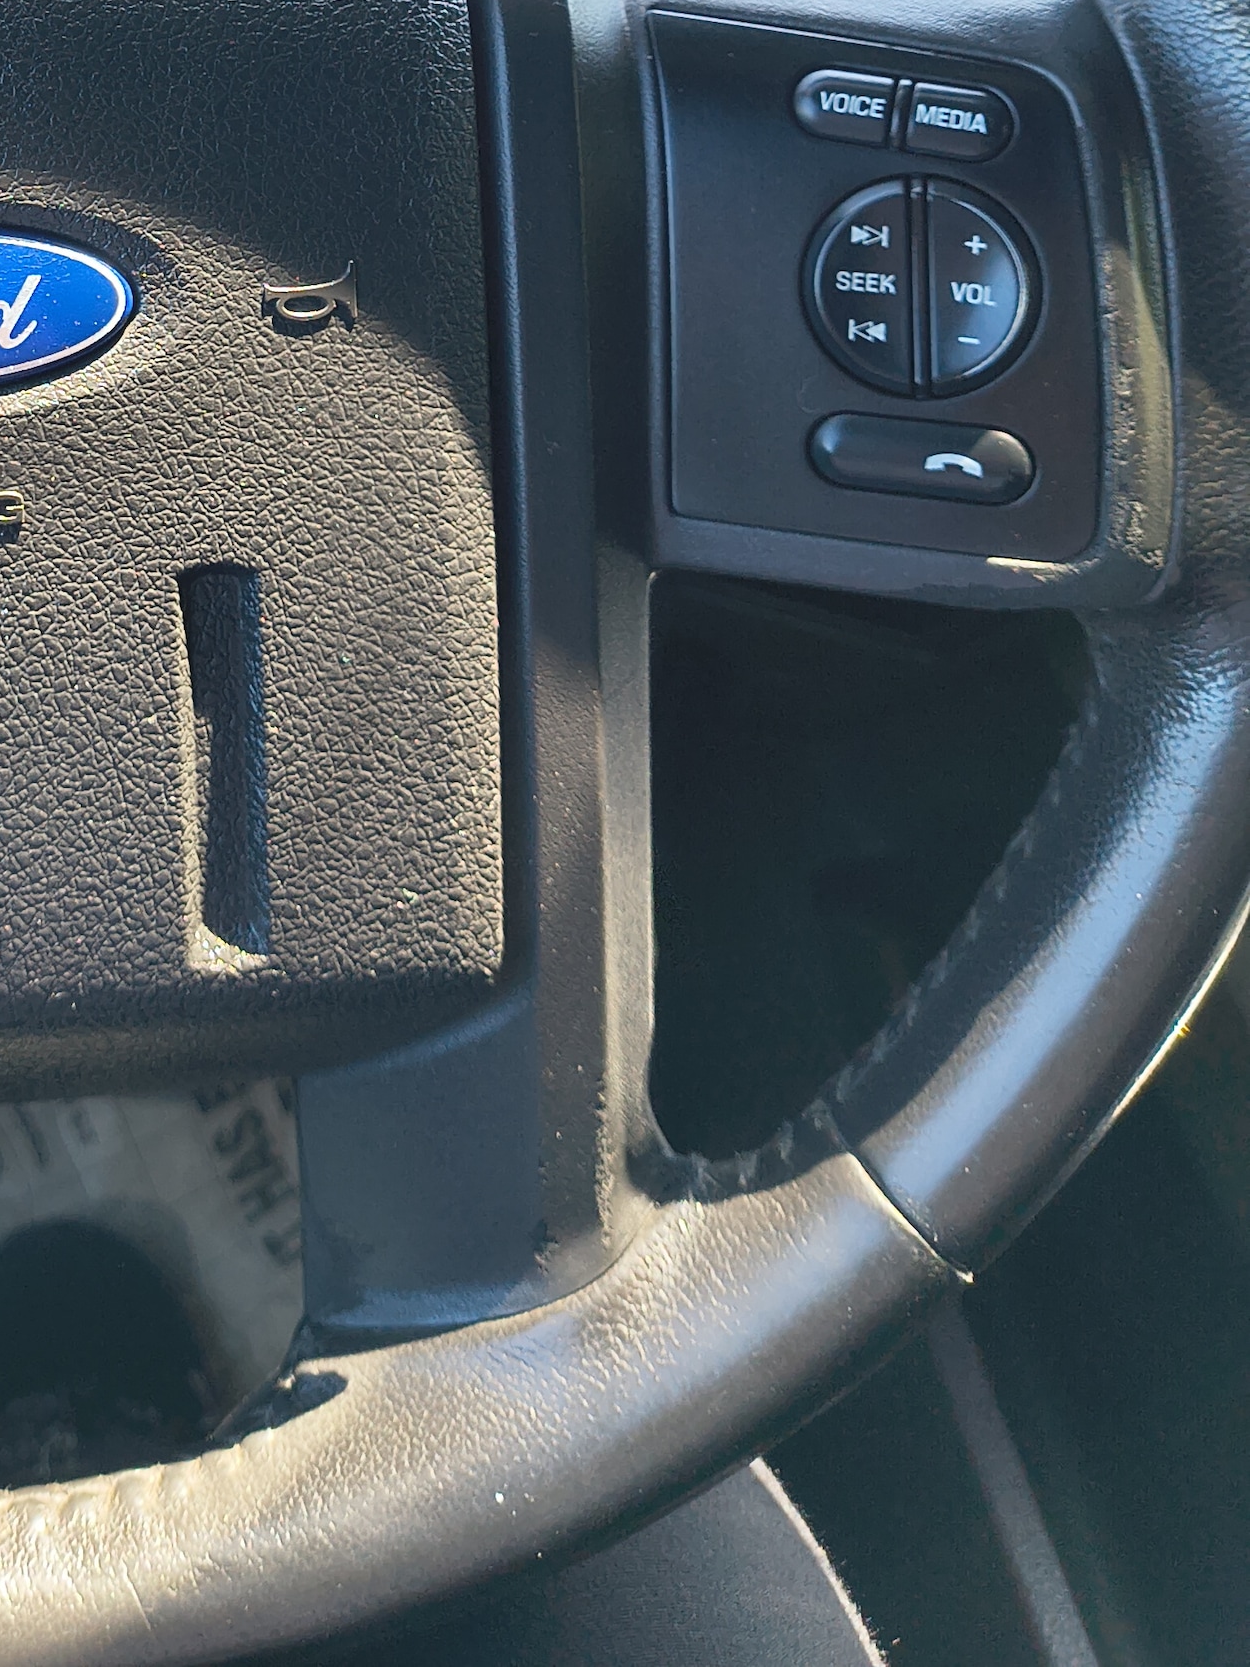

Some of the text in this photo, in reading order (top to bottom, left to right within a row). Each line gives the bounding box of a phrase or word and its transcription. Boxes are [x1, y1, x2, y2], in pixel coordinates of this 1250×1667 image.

[820, 91, 887, 119] VOICE
[915, 103, 988, 134] MEDIA
[836, 271, 897, 295] SEEK
[951, 281, 997, 307] VOL
